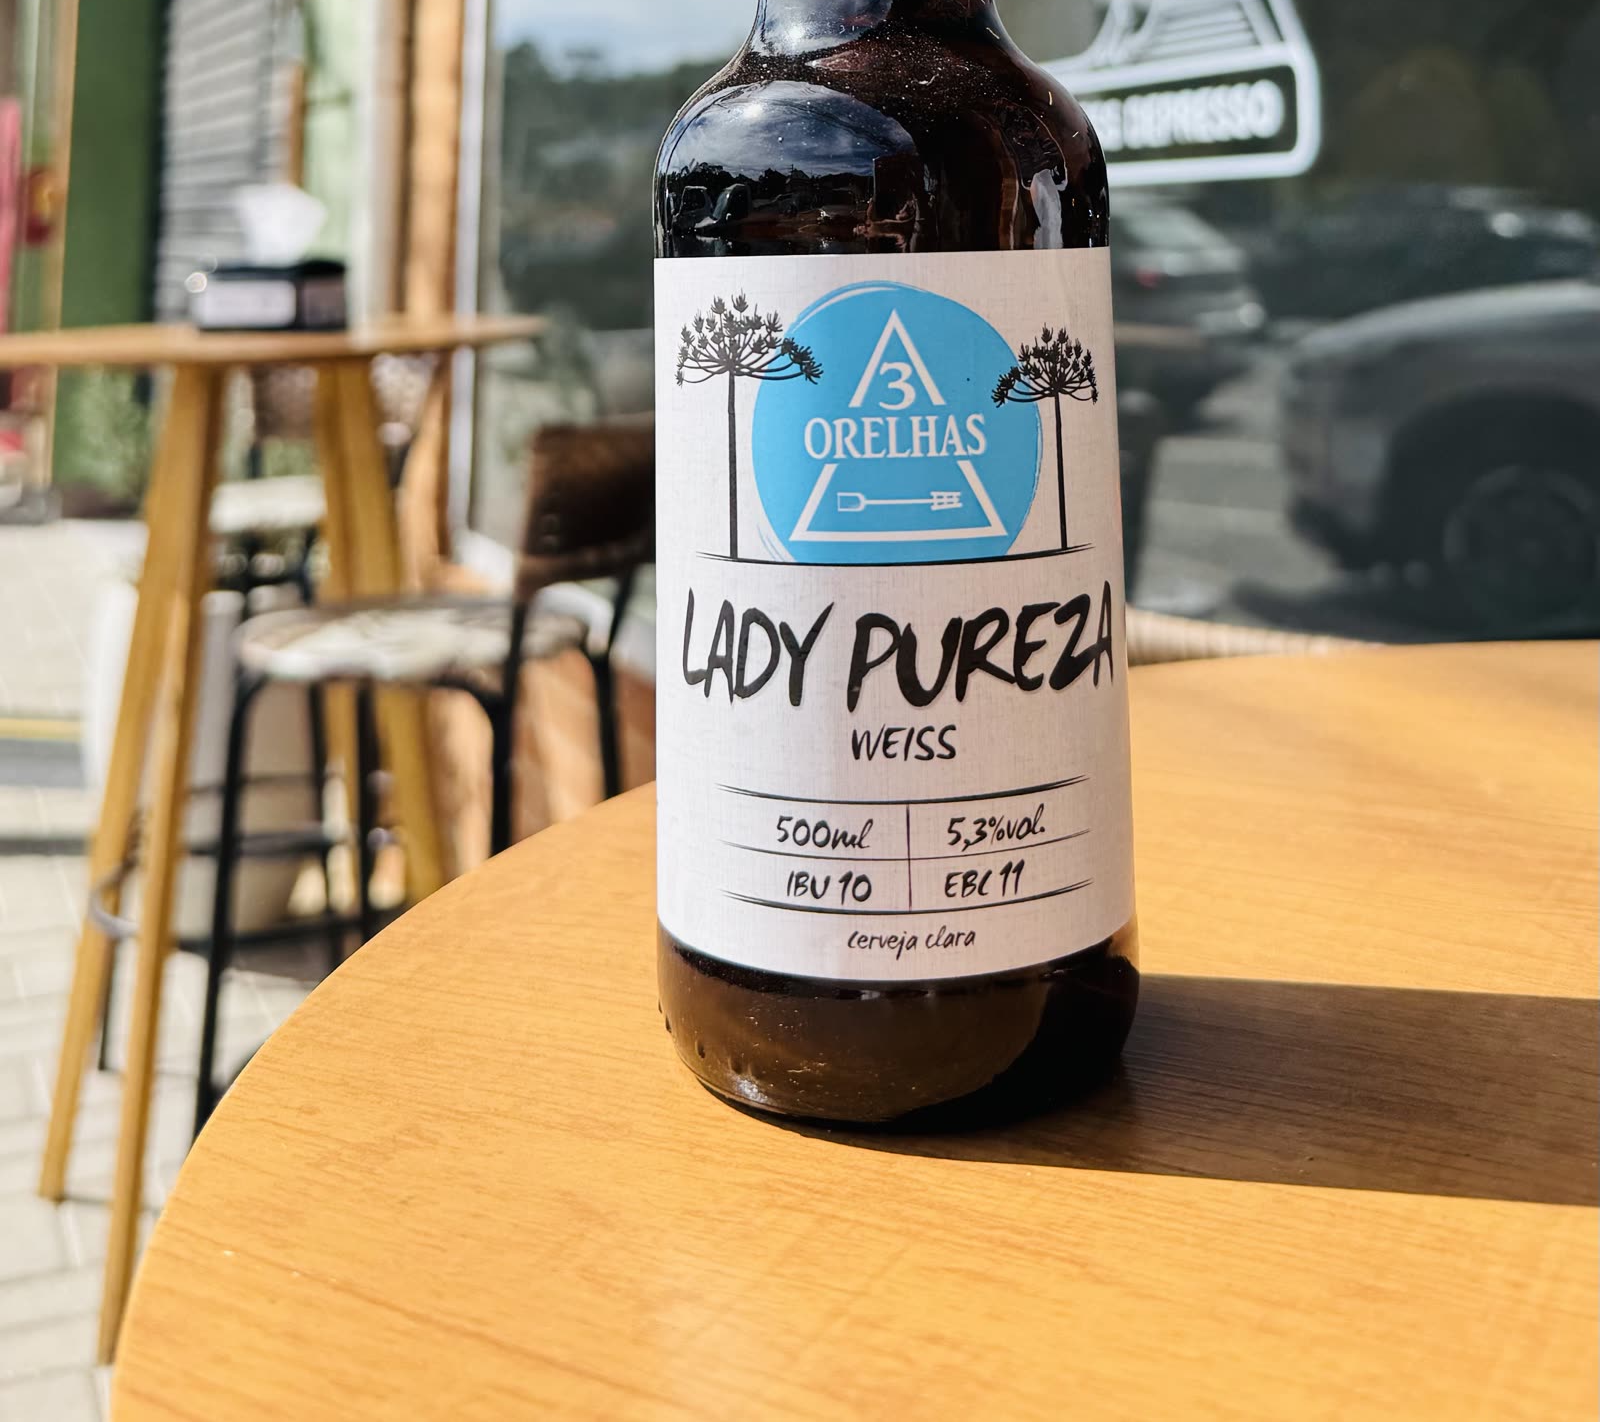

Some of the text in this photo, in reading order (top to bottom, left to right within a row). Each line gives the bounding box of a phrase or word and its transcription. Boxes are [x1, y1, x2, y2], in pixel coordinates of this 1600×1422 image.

[878, 361, 917, 411] 3
[803, 413, 987, 460] ORELHAS
[682, 580, 1115, 714] LADY PUREZA
[851, 724, 957, 762] WEISS
[775, 814, 874, 851] 500ml
[785, 870, 873, 905] IBU 10
[944, 857, 1025, 899] EBC 11
[925, 925, 976, 950] clara
